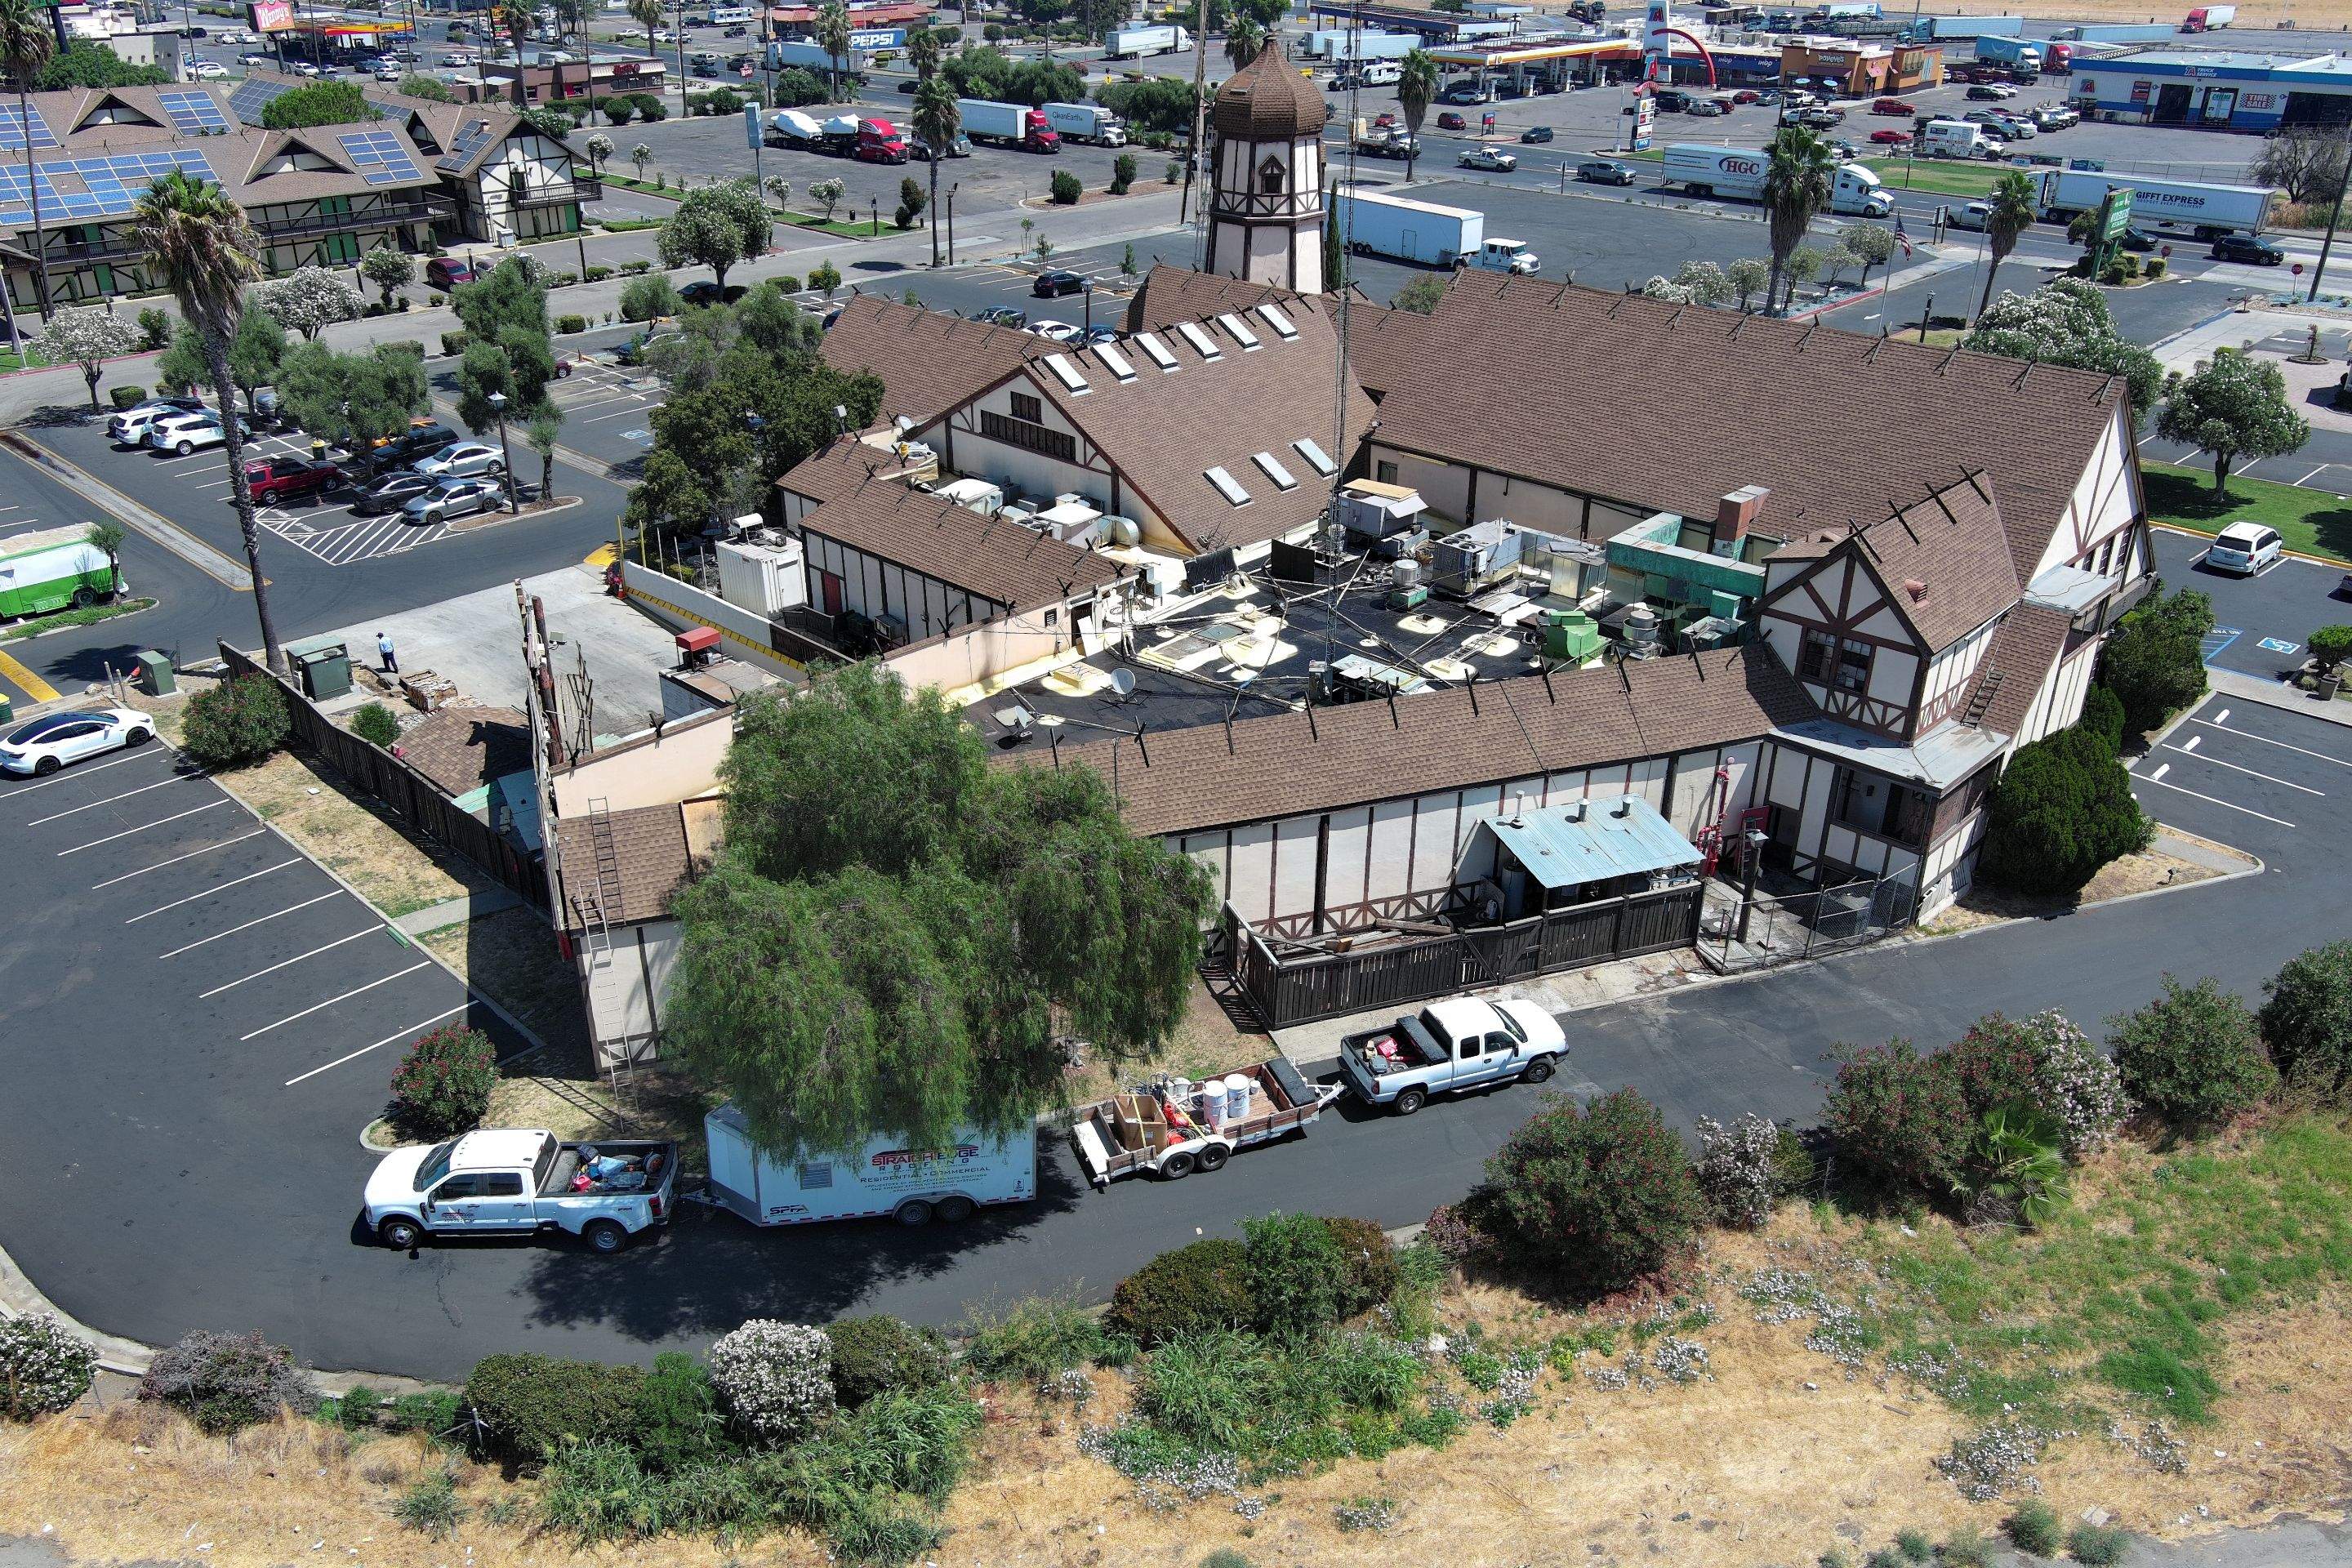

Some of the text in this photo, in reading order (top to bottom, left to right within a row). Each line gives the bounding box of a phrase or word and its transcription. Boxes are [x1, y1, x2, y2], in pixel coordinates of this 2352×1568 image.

[257, 7, 290, 27] Wendy's
[851, 33, 894, 47] PEPSI
[2247, 100, 2267, 109] SALE
[1726, 160, 1760, 175] HGC
[2136, 191, 2205, 205] GIFFT EXPRESS
[860, 1174, 923, 1183] RESIDENTIAL
[930, 1166, 991, 1177] COMMERCIAL
